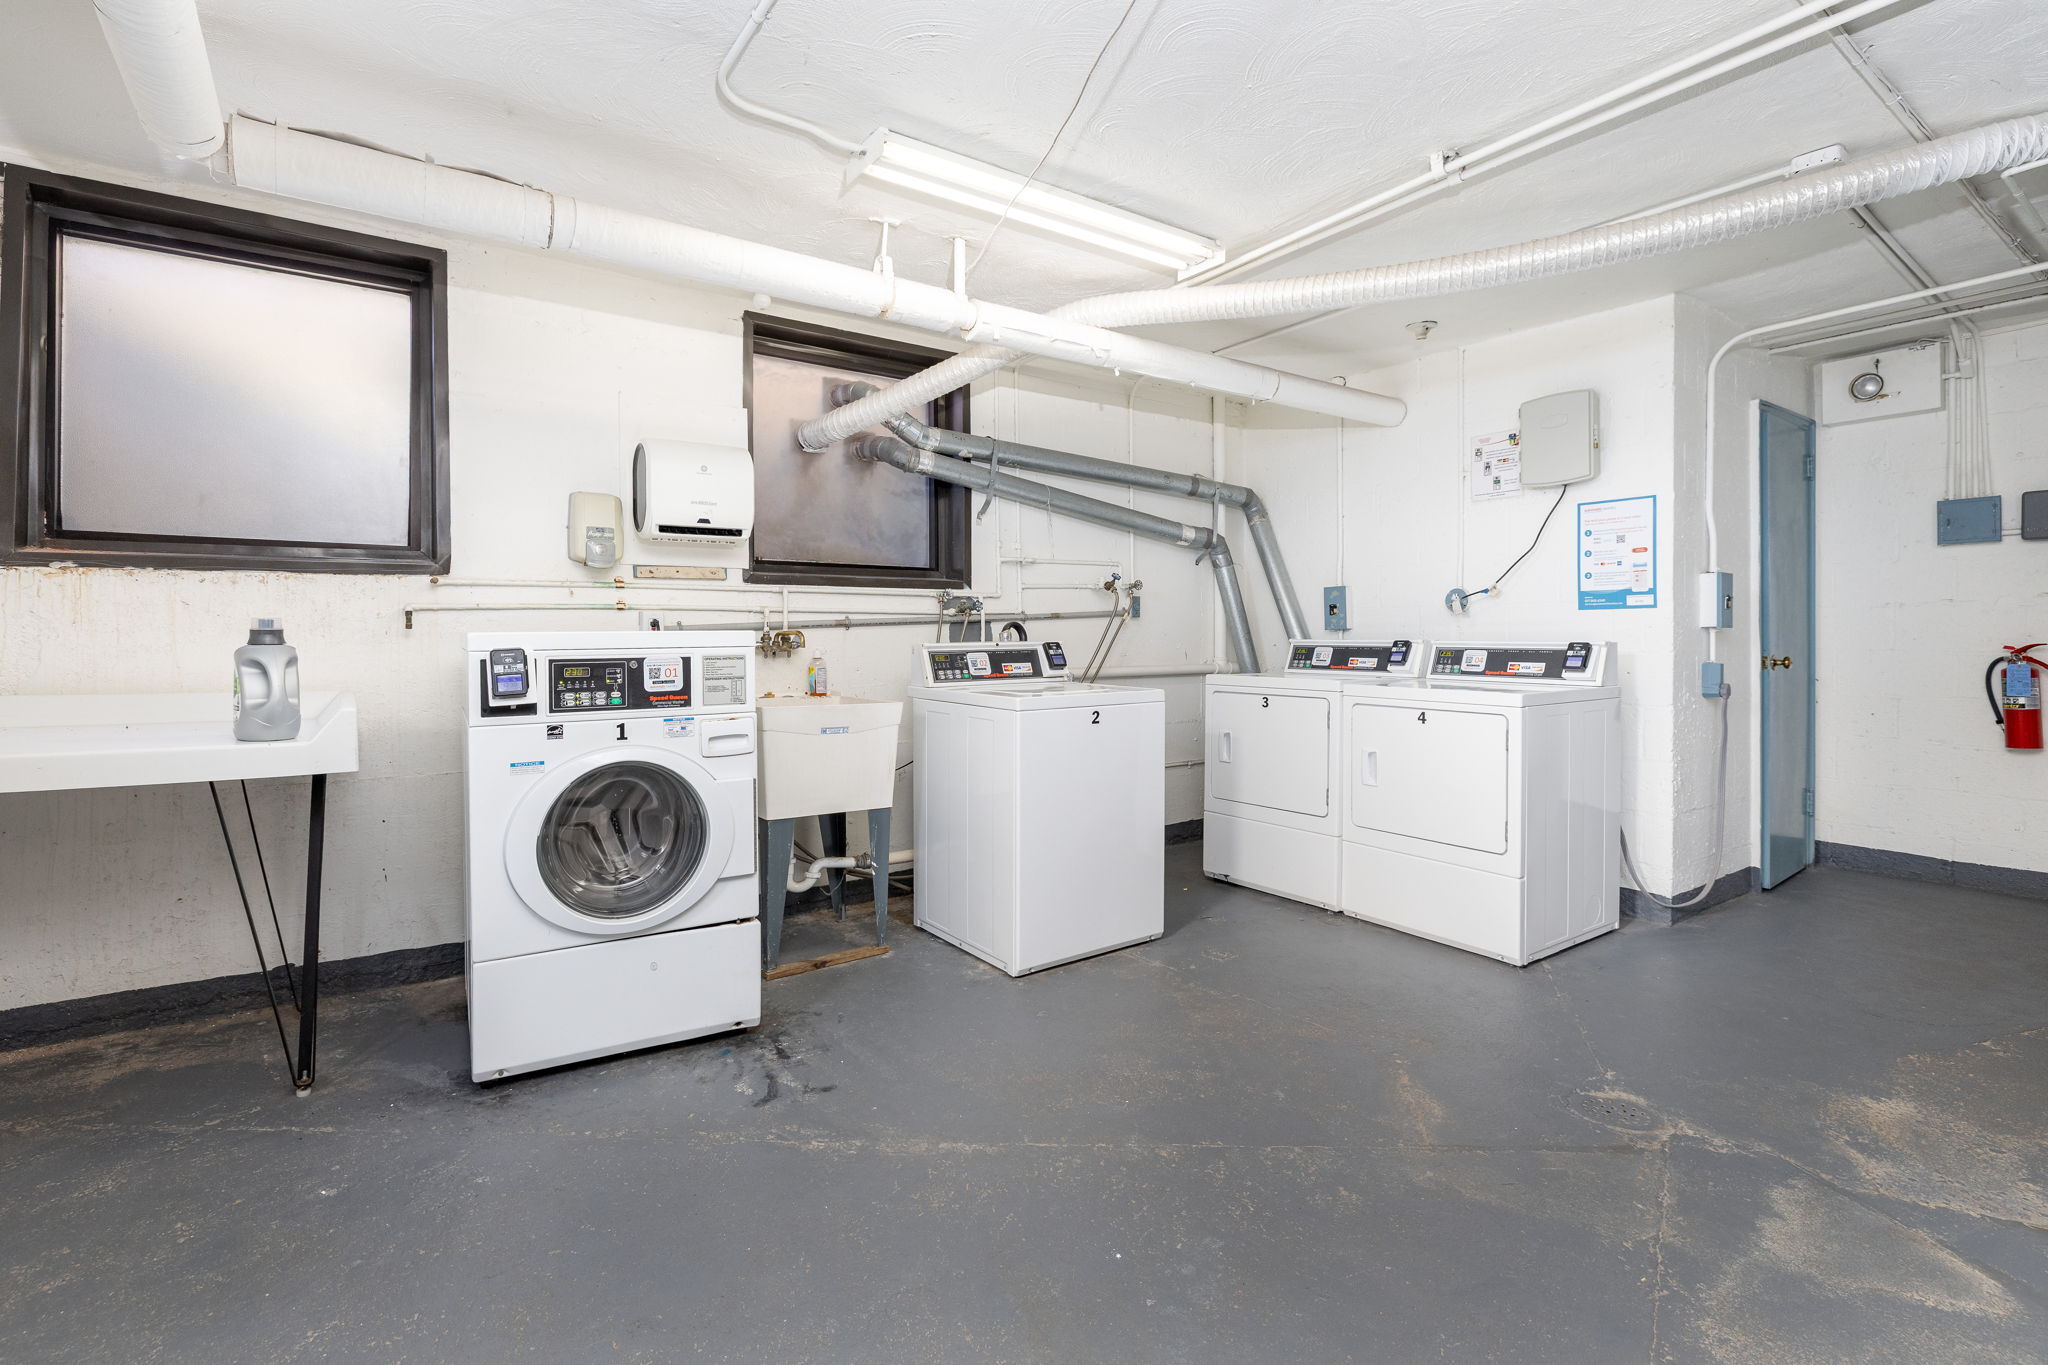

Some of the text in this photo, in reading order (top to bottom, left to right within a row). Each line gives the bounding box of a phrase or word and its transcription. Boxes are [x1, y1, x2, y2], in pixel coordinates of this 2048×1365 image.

[664, 668, 679, 678] 01
[1262, 697, 1269, 708] 3
[1091, 710, 1100, 725] 2
[1417, 711, 1427, 724] 4
[616, 722, 628, 741] 1
